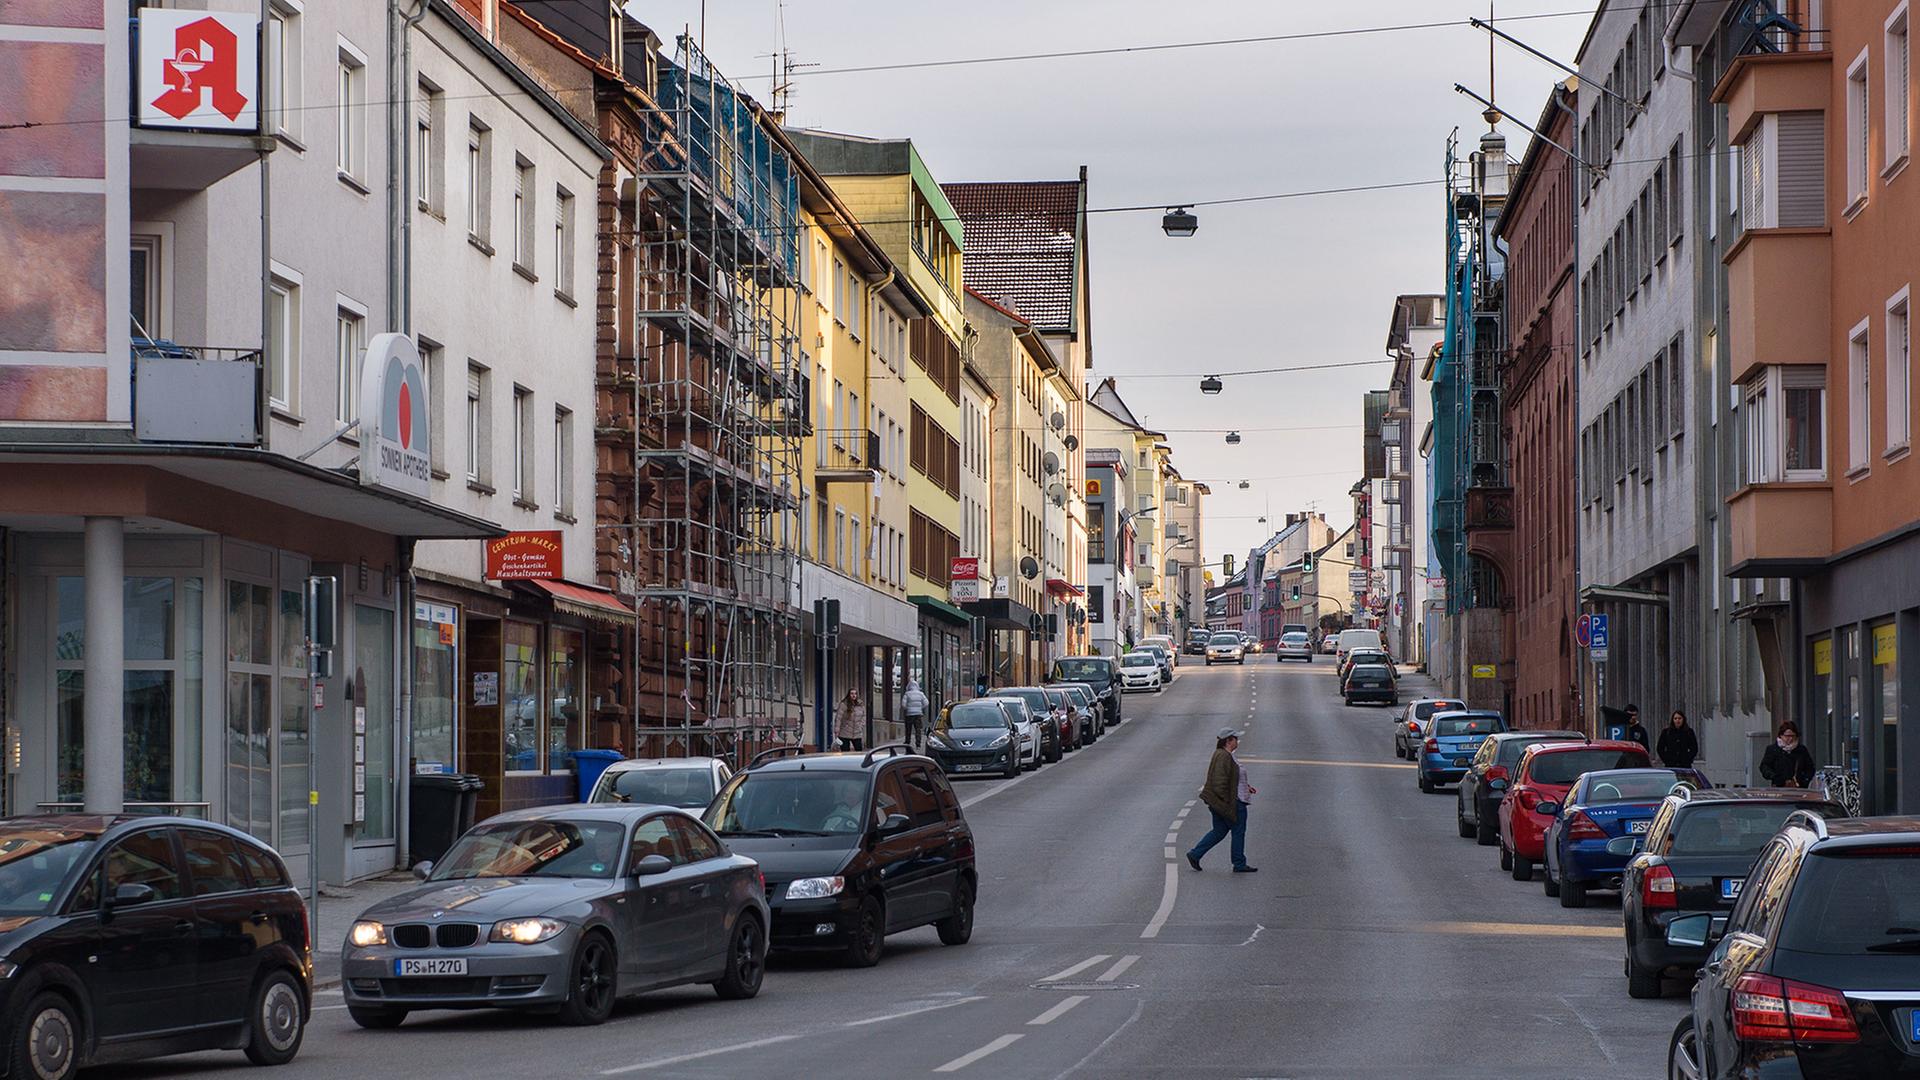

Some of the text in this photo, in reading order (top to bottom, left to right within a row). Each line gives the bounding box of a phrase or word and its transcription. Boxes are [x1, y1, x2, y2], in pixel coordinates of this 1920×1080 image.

[382, 445, 428, 481] SONNEN APOTHEKE
[503, 553, 517, 561] Obst
[522, 553, 545, 562] Gemüse
[502, 562, 547, 571] Geschenkartikel
[496, 570, 553, 578] Haushaltswaren
[1593, 617, 1601, 630] P
[1612, 728, 1621, 740] P
[1632, 822, 1645, 832] PS
[405, 960, 421, 974] PS
